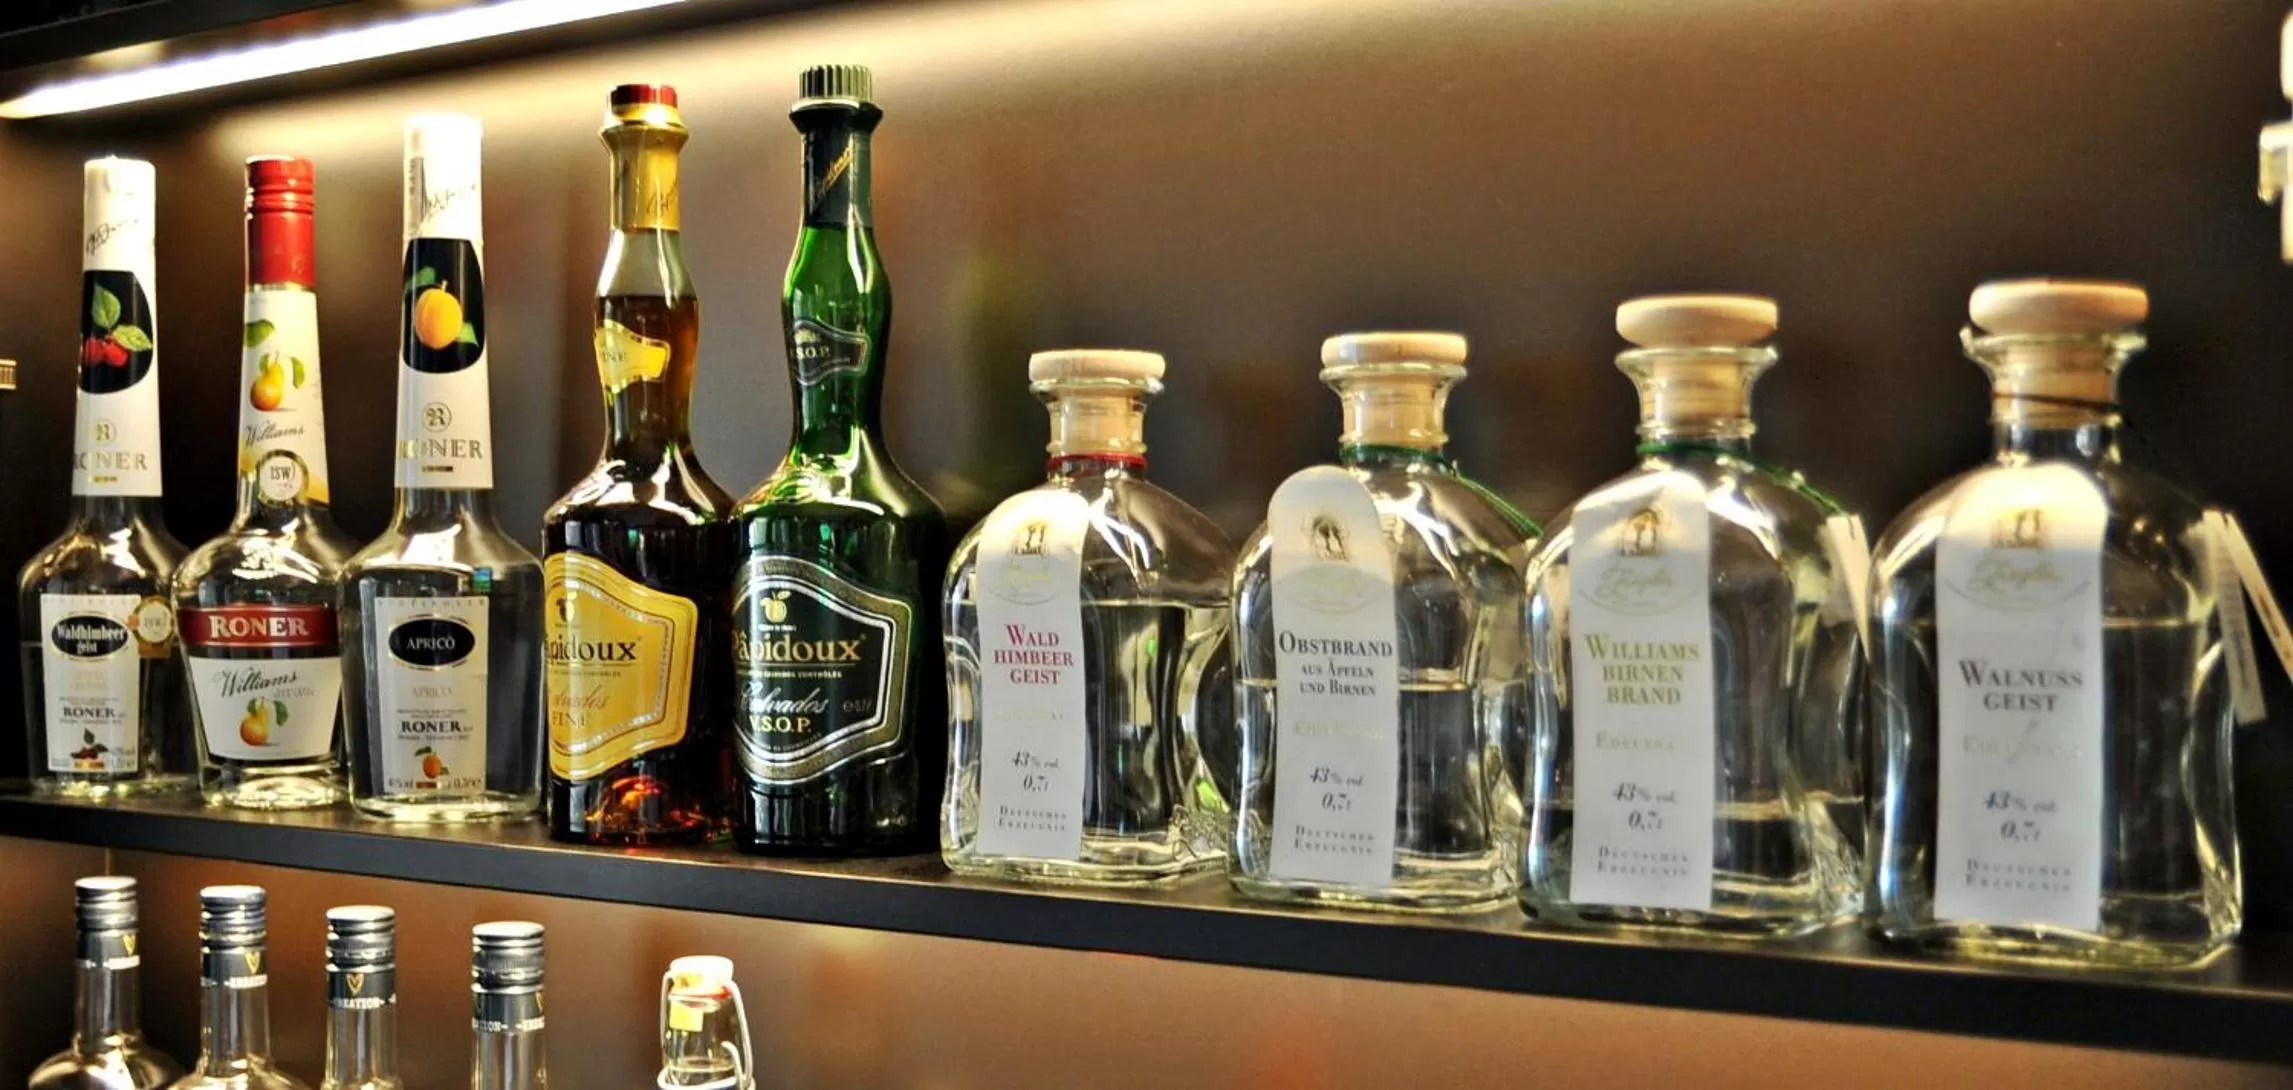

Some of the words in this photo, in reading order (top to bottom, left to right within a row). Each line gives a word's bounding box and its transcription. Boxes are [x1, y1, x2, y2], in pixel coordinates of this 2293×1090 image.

[209, 615, 309, 638] RONER
[1004, 623, 1059, 646] WALD
[1279, 630, 1392, 657] OBSTBRAND
[1583, 633, 1700, 661] WILLIAMS
[994, 650, 1074, 667] HIMBEER
[214, 666, 298, 697] Williams
[1010, 668, 1061, 685] GEIST
[1602, 665, 1683, 682] BIRNEN
[1957, 659, 2083, 689] WALNUSS
[1607, 686, 1681, 705] BRAND
[1982, 692, 2058, 712] GEIST
[63, 707, 116, 720] RONER
[401, 720, 461, 733] RONER
